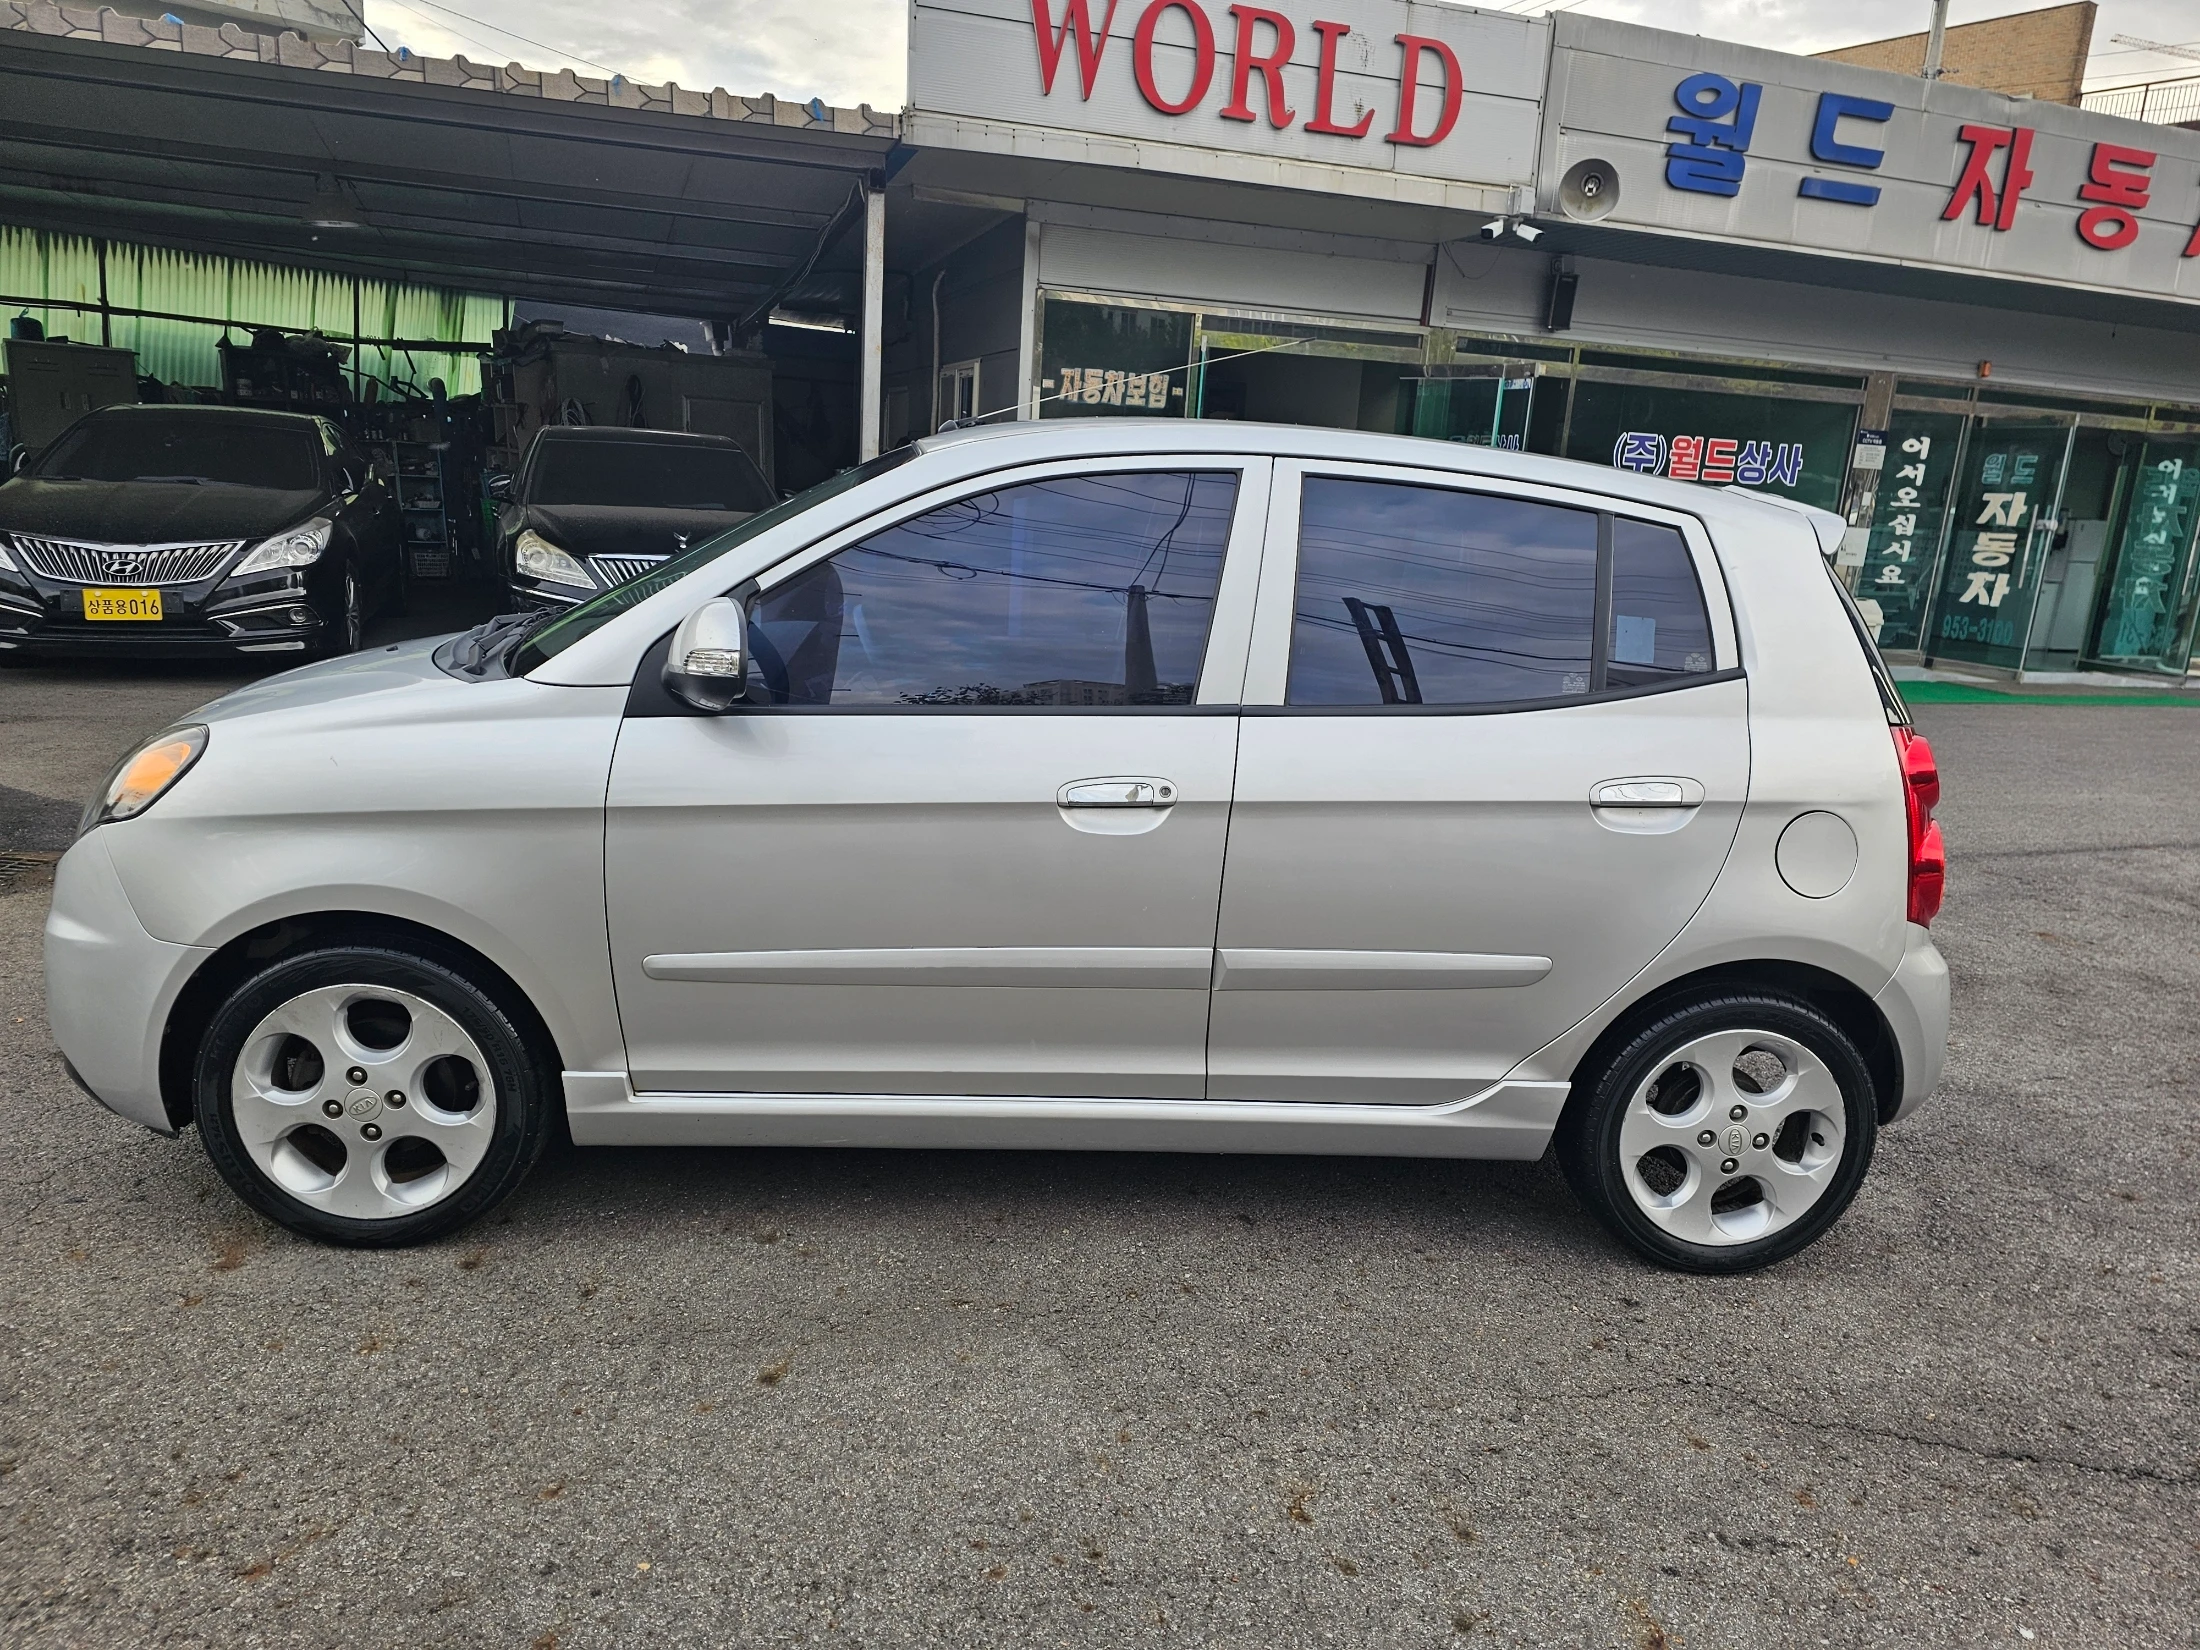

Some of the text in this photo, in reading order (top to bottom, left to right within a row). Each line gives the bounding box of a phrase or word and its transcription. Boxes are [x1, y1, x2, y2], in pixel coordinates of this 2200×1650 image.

[1031, 0, 1463, 147] WORLD
[1665, 72, 2200, 257] 월드 자동
[1059, 367, 1170, 409] 자동차보험
[1613, 432, 1804, 487] (주)월드상사
[1982, 453, 2038, 485] 월드
[1875, 436, 1931, 584] 어서오십시요
[1959, 491, 2028, 607] 자동차
[88, 599, 159, 615] 상품용016
[1942, 615, 2015, 645] 953-3100
[353, 1099, 374, 1113] KIA
[1731, 1132, 1740, 1151] KIA
